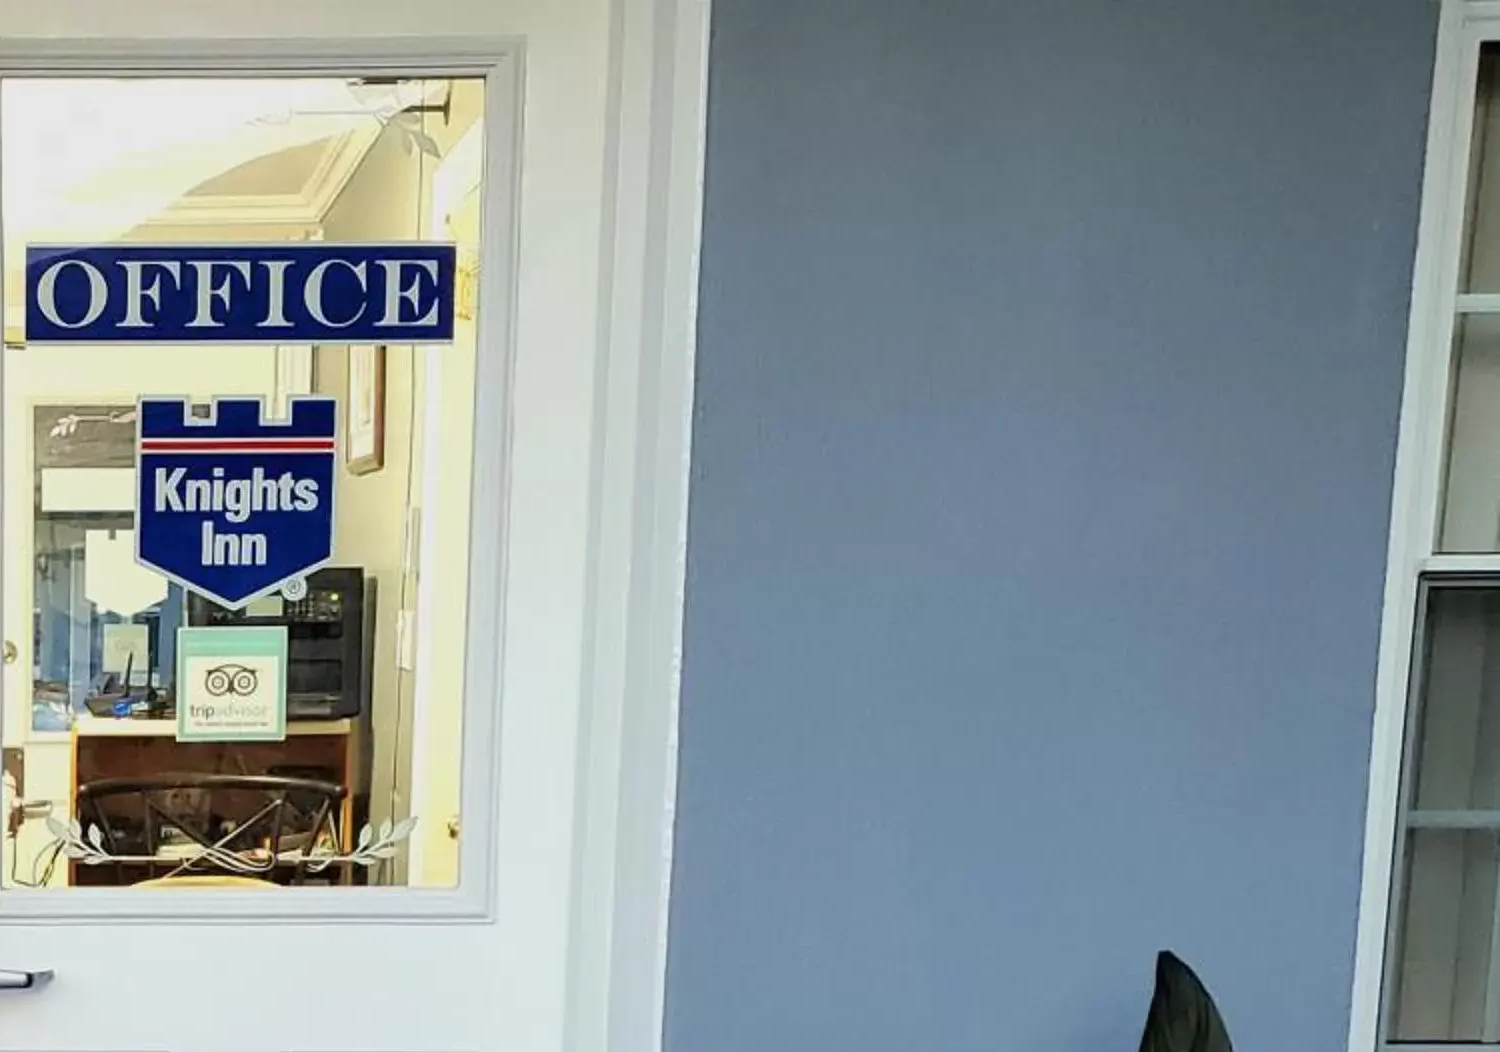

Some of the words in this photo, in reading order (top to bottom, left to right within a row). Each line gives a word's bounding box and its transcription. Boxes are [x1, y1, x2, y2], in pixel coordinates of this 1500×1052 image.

[37, 259, 439, 329] OFFICE
[155, 467, 319, 521] Knights
[201, 521, 268, 566] Inn
